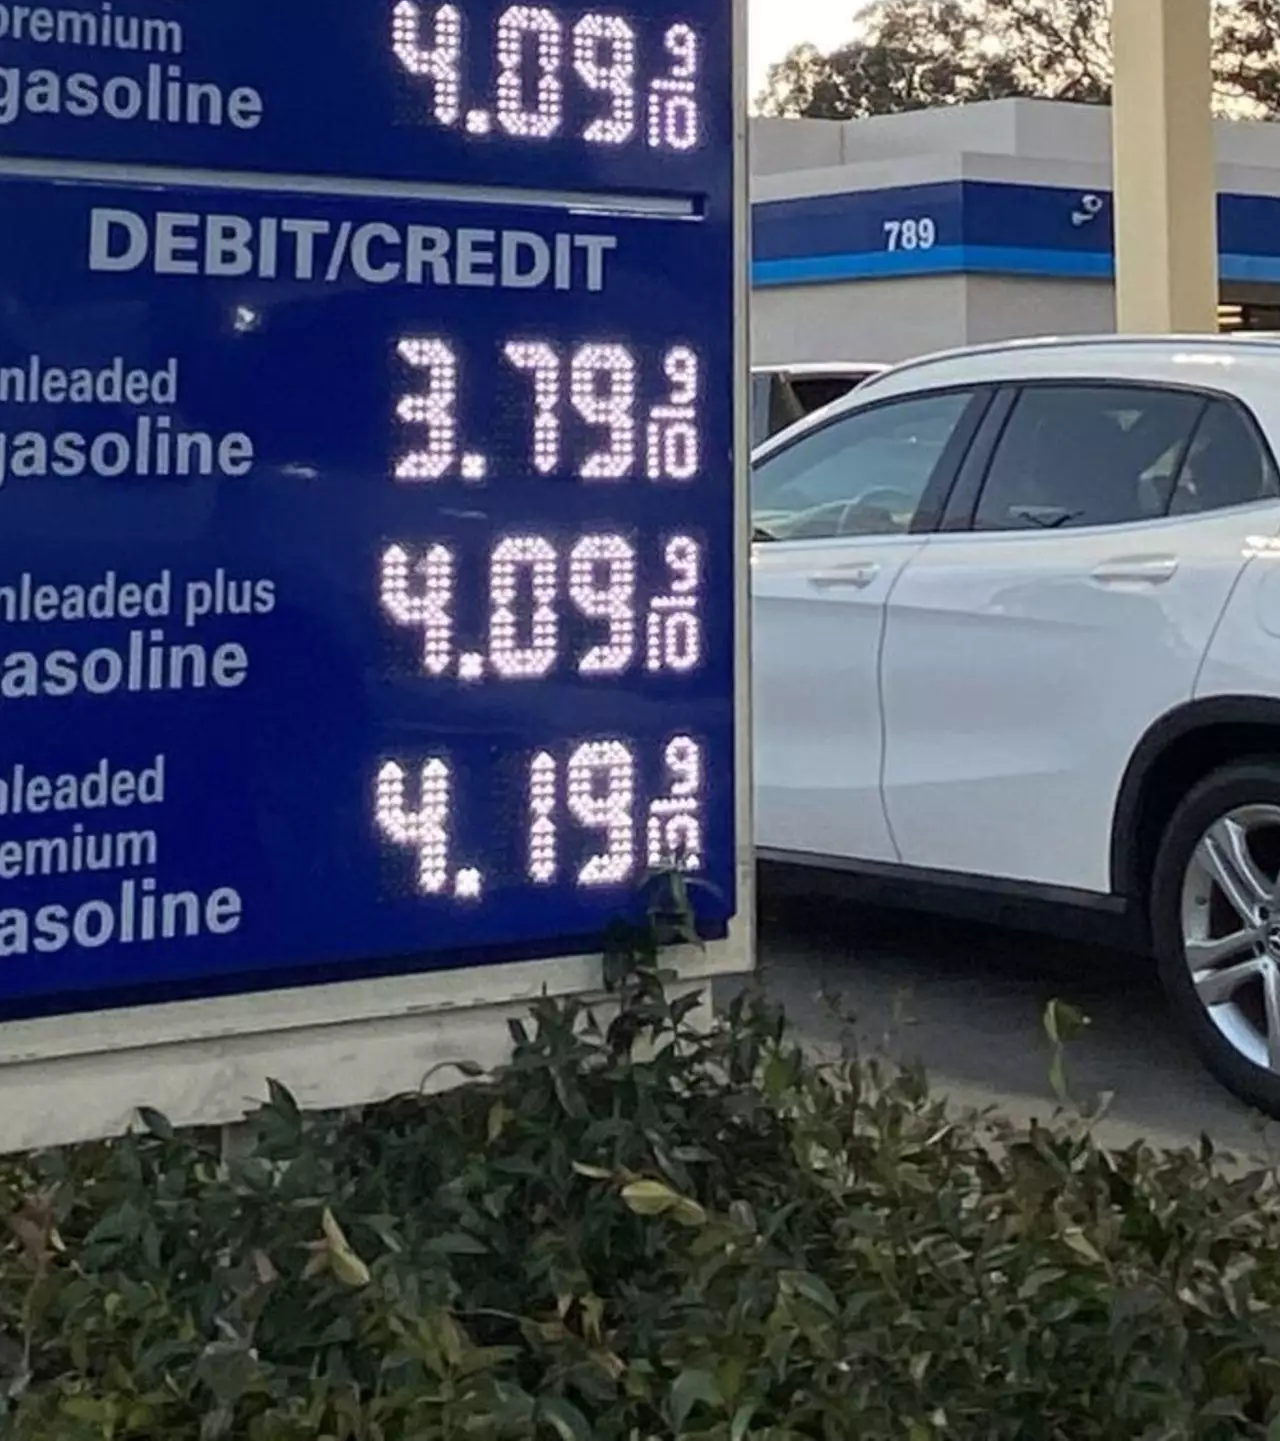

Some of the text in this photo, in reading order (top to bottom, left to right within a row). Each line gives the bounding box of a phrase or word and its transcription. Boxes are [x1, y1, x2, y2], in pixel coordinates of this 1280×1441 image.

[392, 0, 636, 144] 4.09
[88, 207, 618, 292] DEBIT/CREDIT
[883, 217, 936, 253] 789
[395, 337, 636, 480] 3.79
[185, 568, 276, 627] plus
[380, 534, 637, 680] 4.09
[375, 740, 635, 899] 4.19
